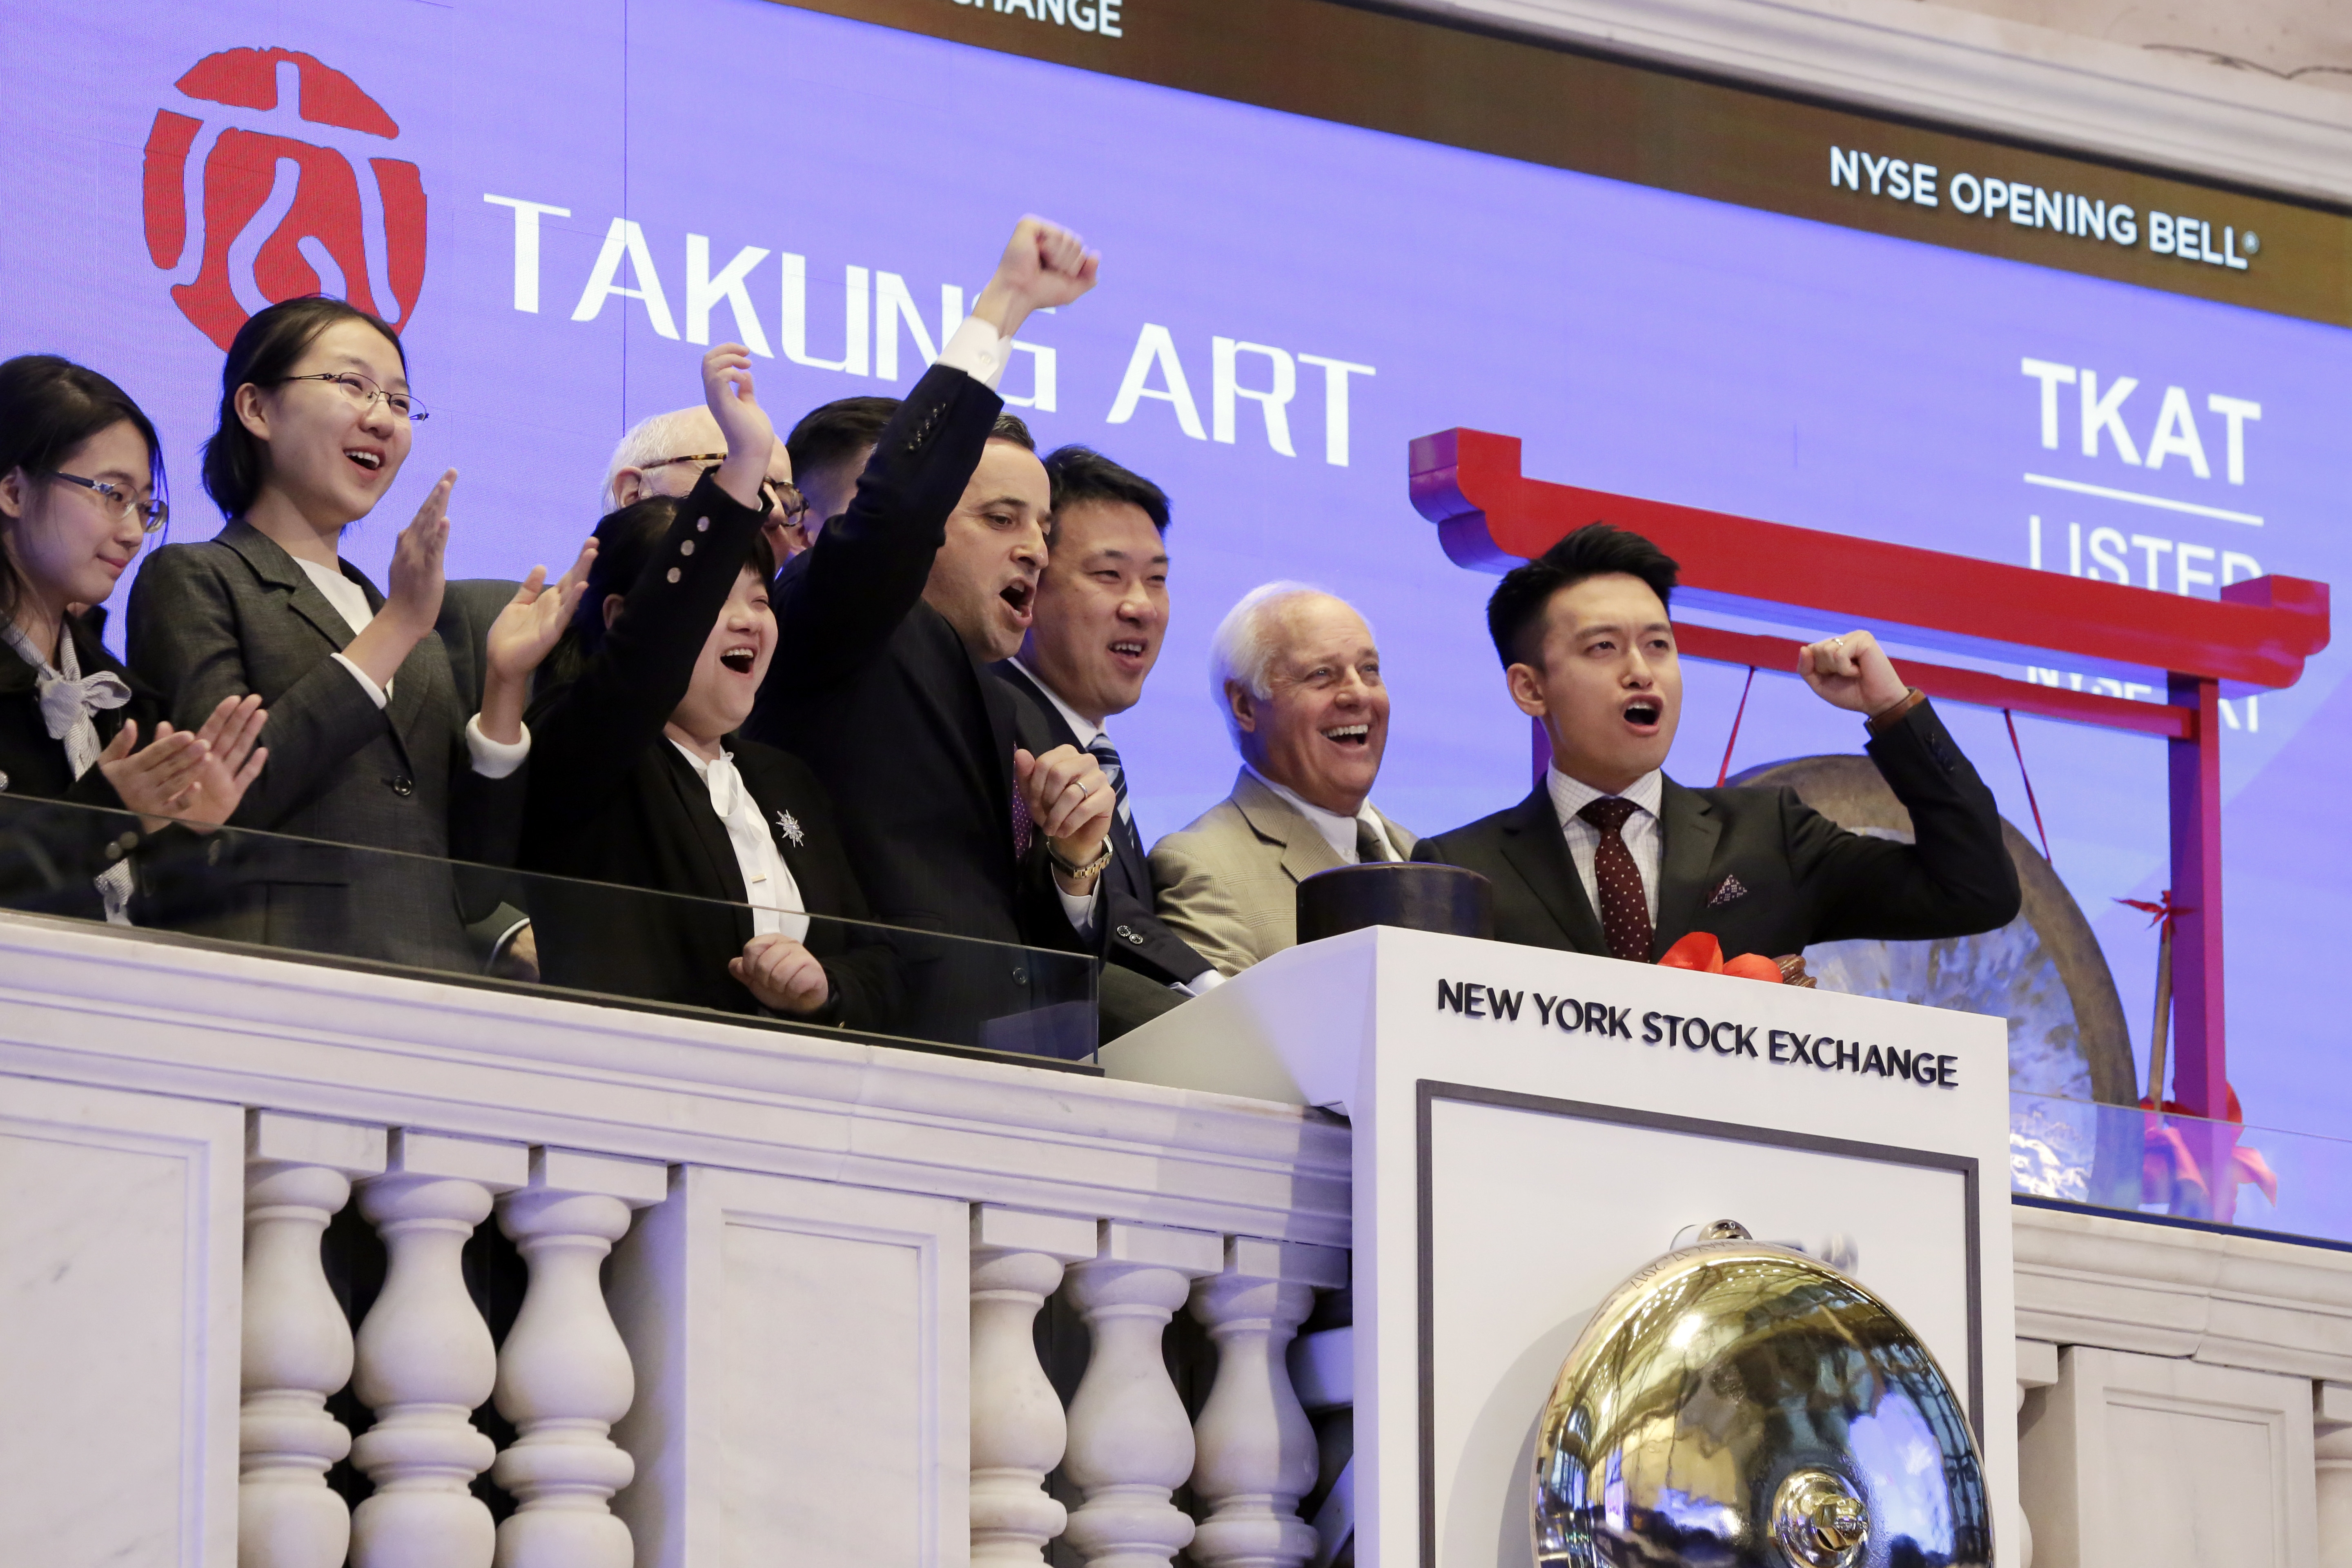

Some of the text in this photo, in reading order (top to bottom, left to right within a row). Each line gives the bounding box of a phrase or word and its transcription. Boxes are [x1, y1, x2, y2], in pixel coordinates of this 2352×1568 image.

[952, 0, 1123, 38] ANGE
[1830, 146, 1938, 207] NYSE
[1950, 172, 2137, 245] OPENING
[1106, 323, 1376, 467] ART
[2021, 357, 2262, 485] TKAT
[1438, 979, 1959, 1087] NEW YORK STOCK EXCHANGE
[1630, 1263, 1666, 1290] 2017
